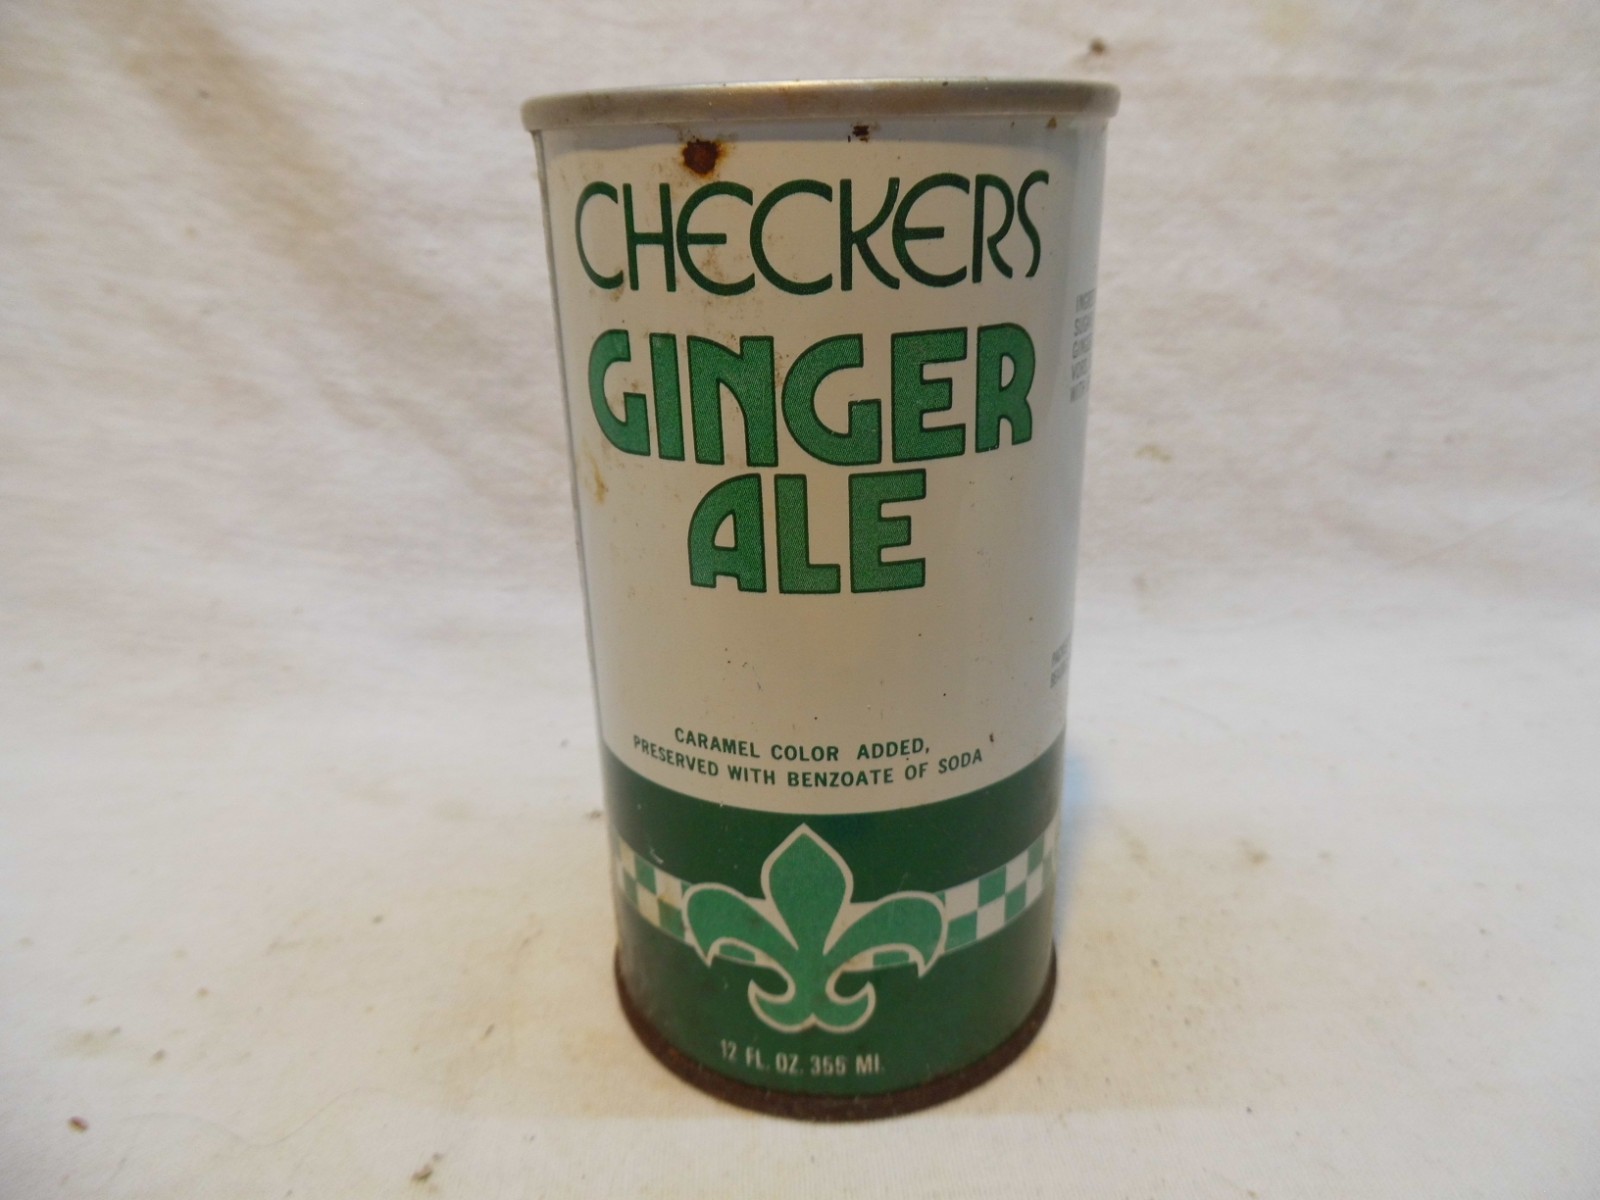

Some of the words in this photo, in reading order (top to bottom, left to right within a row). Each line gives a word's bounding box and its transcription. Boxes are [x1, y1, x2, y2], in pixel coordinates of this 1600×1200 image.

[574, 170, 1050, 296] CHECKERS
[587, 322, 1036, 467] GINGER
[687, 468, 927, 594] ALE
[633, 734, 719, 776] PRESERVED
[727, 764, 775, 785] WITH
[787, 768, 893, 787] BENZOATE
[904, 762, 928, 780] OF
[938, 748, 982, 774] SODA
[674, 727, 760, 758] CARAMEL
[771, 744, 839, 762] COLOR
[856, 737, 930, 760] ADDED,
[720, 1038, 737, 1062] 12
